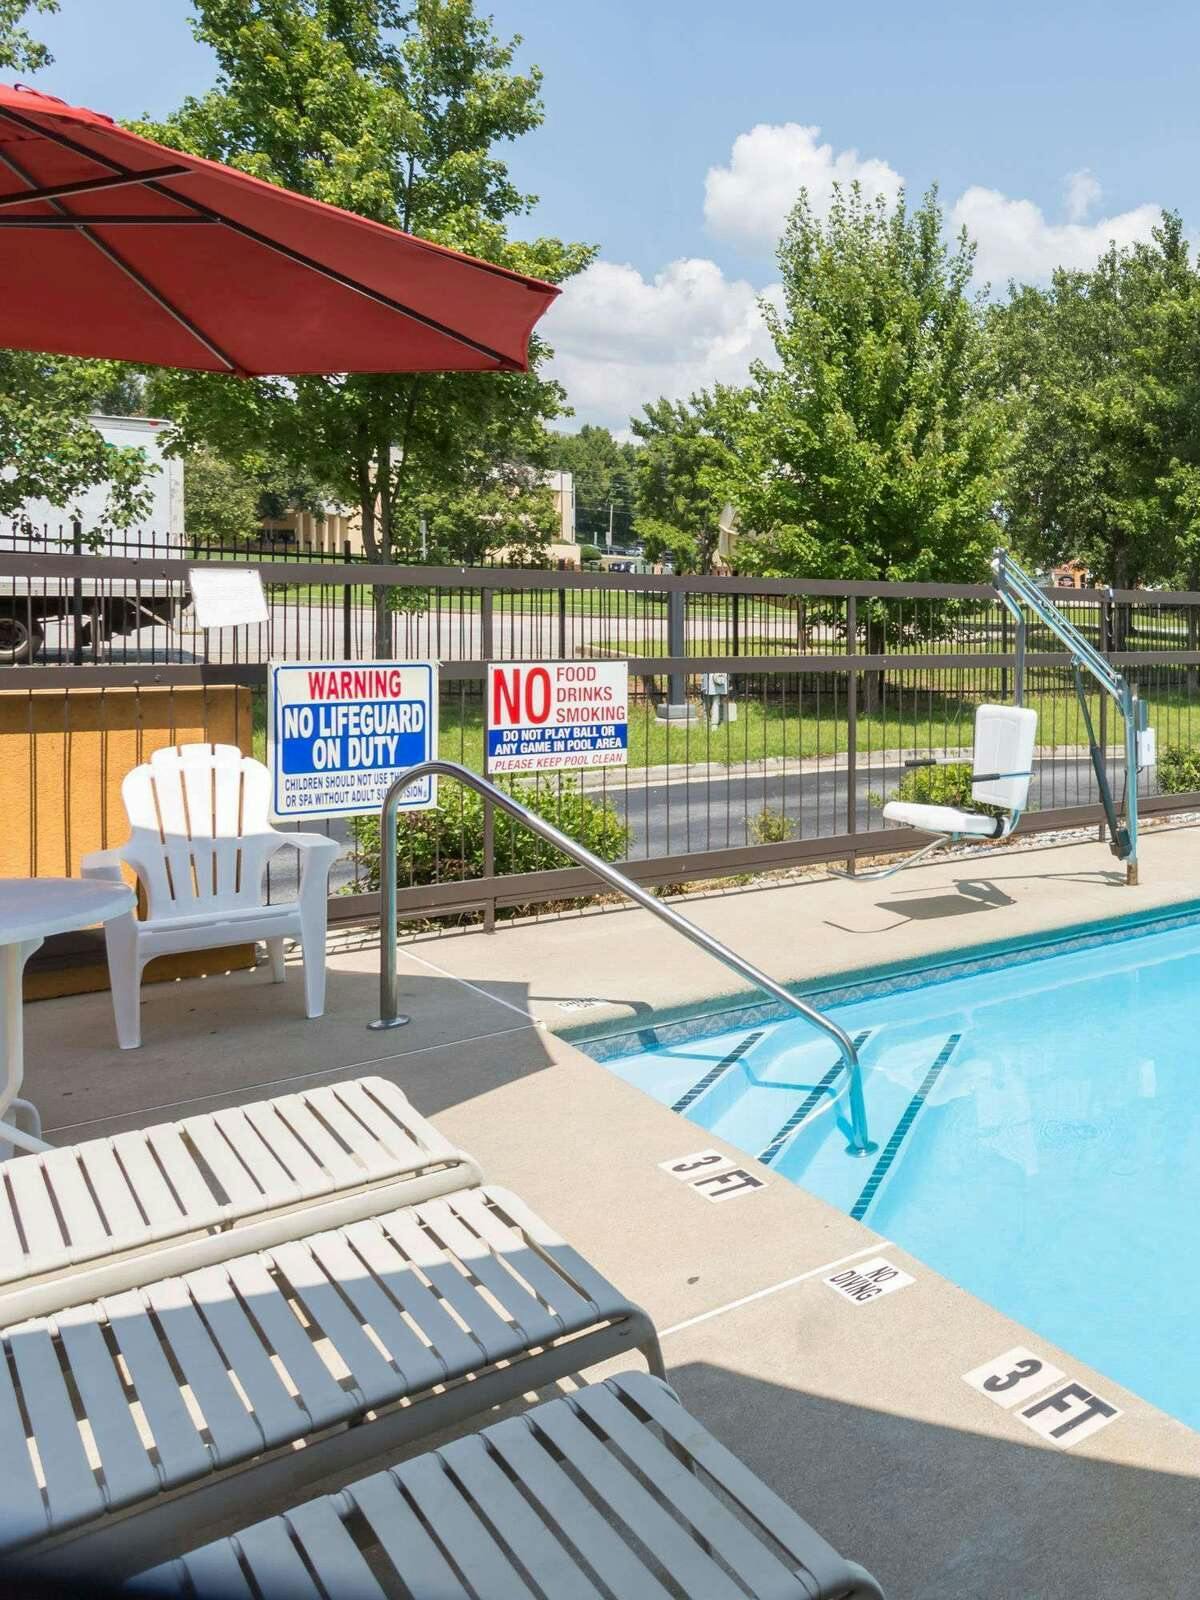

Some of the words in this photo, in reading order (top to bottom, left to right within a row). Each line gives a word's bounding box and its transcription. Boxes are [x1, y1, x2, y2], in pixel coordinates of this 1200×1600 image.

[556, 666, 597, 682] FOOD
[307, 670, 401, 700] WARNING
[556, 686, 613, 703] DRINKS
[493, 667, 552, 726] NO
[284, 706, 314, 739] NO
[319, 703, 424, 737] LIFEGUARD
[556, 705, 625, 723] SMOKING
[503, 730, 518, 742] DO
[521, 729, 543, 741] NOT
[545, 728, 571, 740] PLAY
[573, 726, 599, 738] BALL
[601, 725, 615, 737] OR
[312, 738, 341, 770] ON
[348, 735, 400, 768] DUTY
[495, 743, 517, 755] ANY
[520, 741, 552, 753] GAME
[553, 740, 565, 752] IN
[567, 739, 593, 751] POOL
[596, 737, 622, 749] AREA
[494, 759, 534, 771] PLEASE
[536, 757, 561, 768] KEEP
[564, 755, 589, 767] POOL
[591, 753, 622, 764] CLEAN
[285, 776, 323, 791] CHILDREN
[325, 775, 355, 788] SHOULD
[357, 773, 372, 786] NOT
[374, 772, 388, 785] USE
[286, 794, 297, 808] OR
[299, 793, 313, 807] SPA
[315, 791, 349, 805] WITHOUT
[352, 788, 375, 802] ADULT
[672, 1155, 722, 1172] 3
[693, 1169, 764, 1197] FT
[864, 1265, 899, 1282] NO
[829, 1270, 882, 1301] DIVING
[983, 1359, 1043, 1392] 3
[1021, 1382, 1118, 1439] FT
